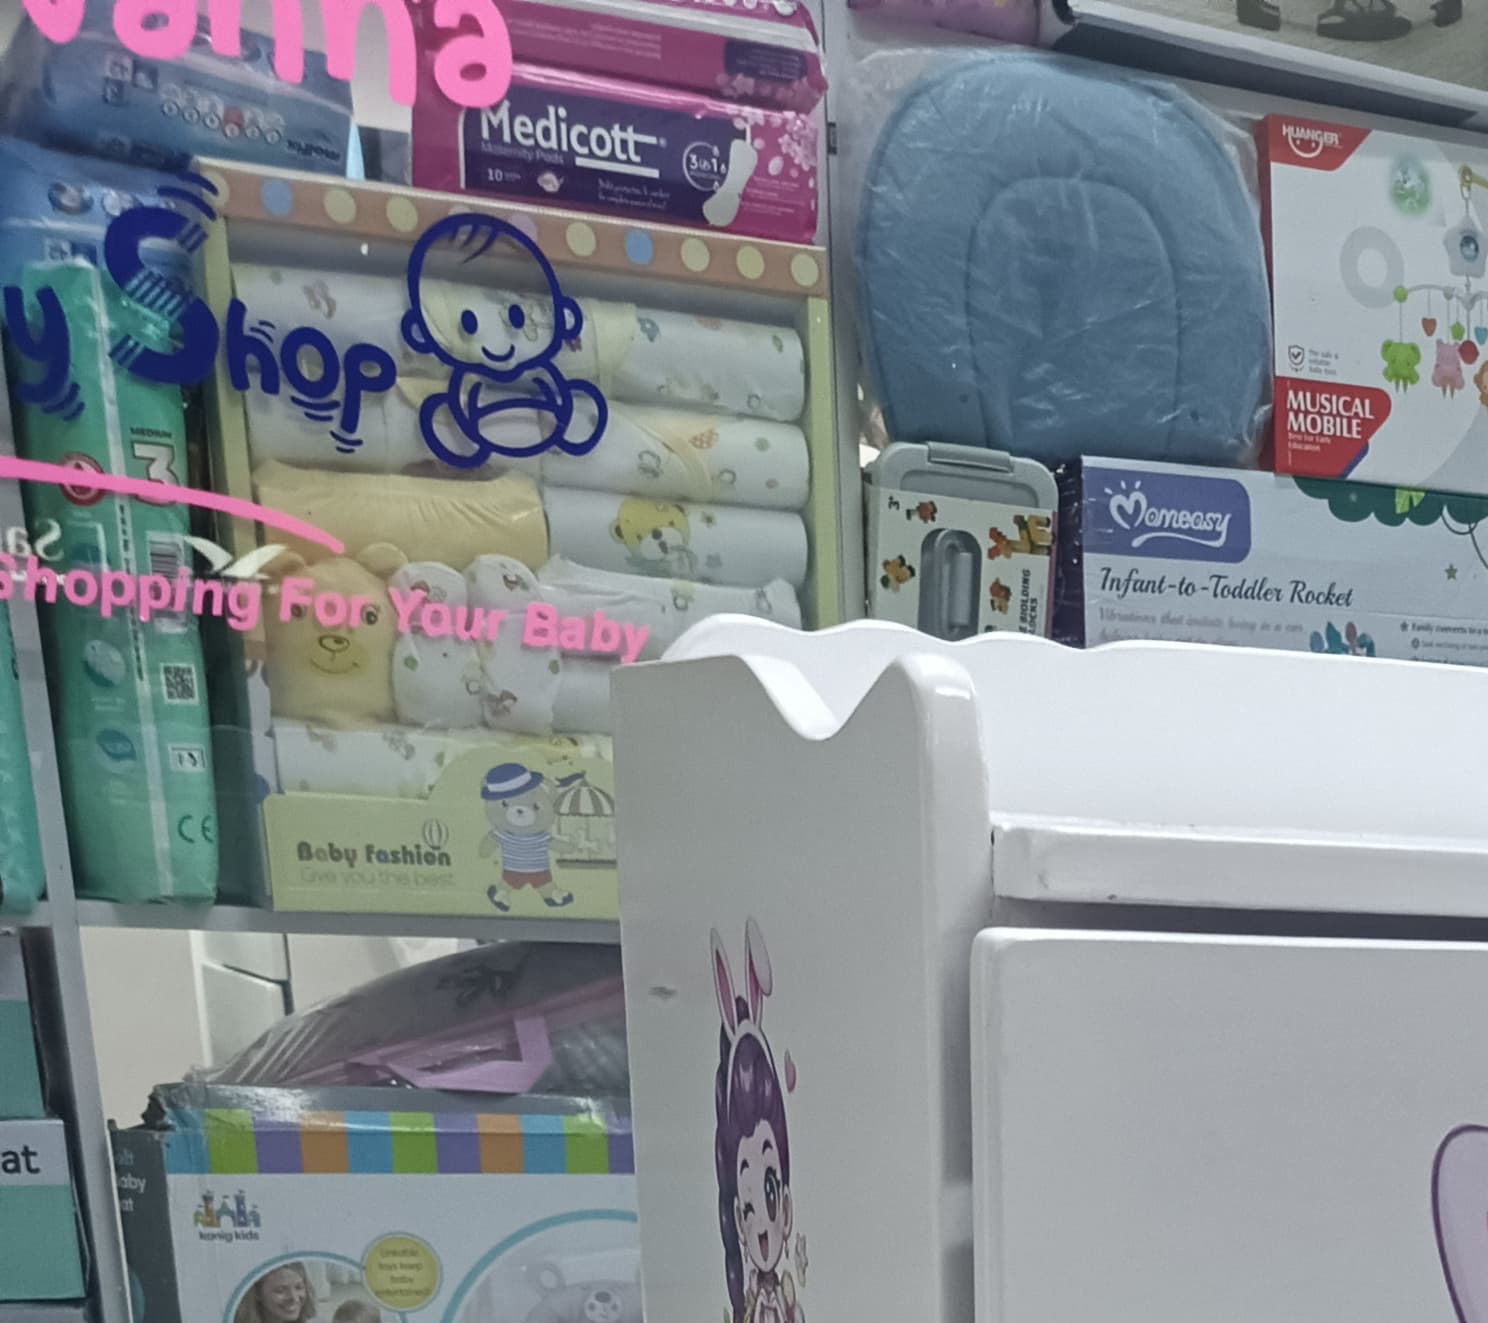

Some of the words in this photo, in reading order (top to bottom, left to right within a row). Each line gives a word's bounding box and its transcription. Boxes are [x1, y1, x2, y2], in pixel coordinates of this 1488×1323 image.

[480, 98, 658, 163] Medicott
[105, 205, 398, 433] Shop
[1286, 389, 1375, 420] MUSICAL
[1287, 411, 1362, 440] MOBILE
[132, 441, 181, 505] 3
[1109, 489, 1231, 542] Momeasy
[279, 575, 373, 628] For
[388, 586, 509, 641] Your
[523, 602, 652, 664] Baby
[1290, 579, 1353, 607] Rocket
[297, 841, 358, 868] Baby
